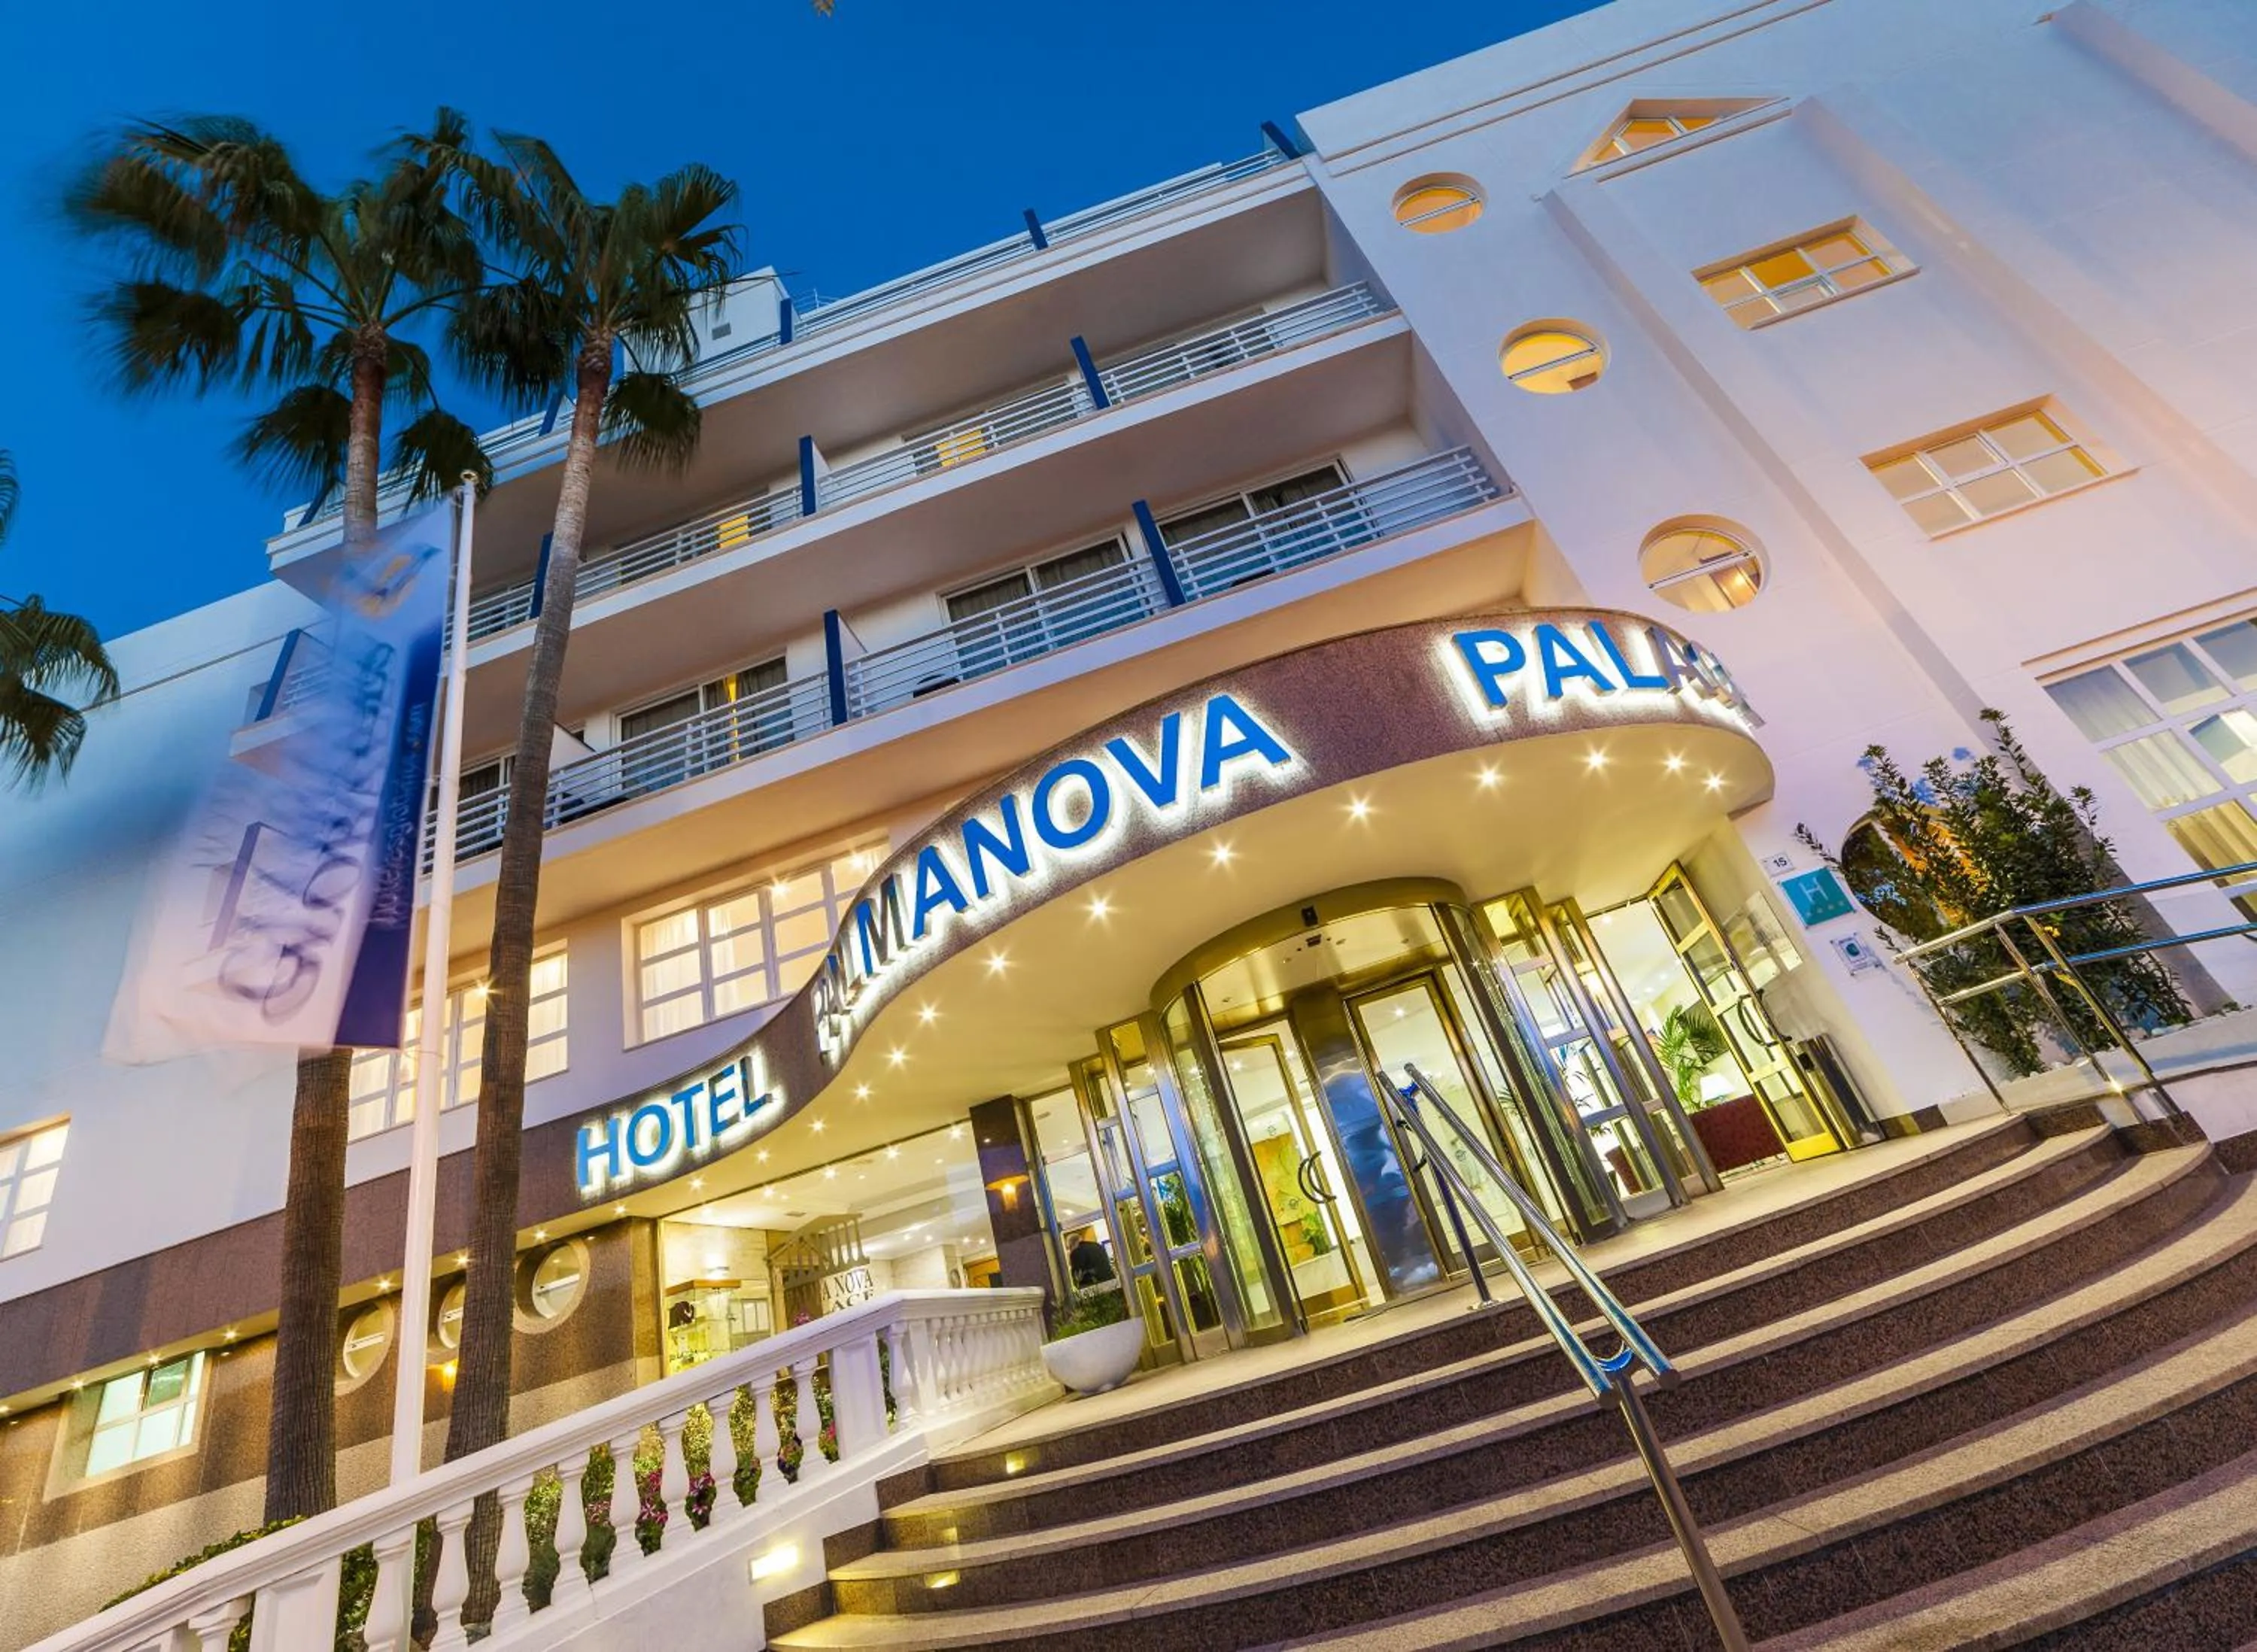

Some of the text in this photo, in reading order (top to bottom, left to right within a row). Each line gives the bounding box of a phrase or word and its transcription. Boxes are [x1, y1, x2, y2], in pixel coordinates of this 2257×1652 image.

[1773, 857, 1788, 867] 15
[1798, 876, 1830, 904] H
[576, 1055, 773, 1189] HOTEL
[834, 1268, 873, 1298] NOVA
